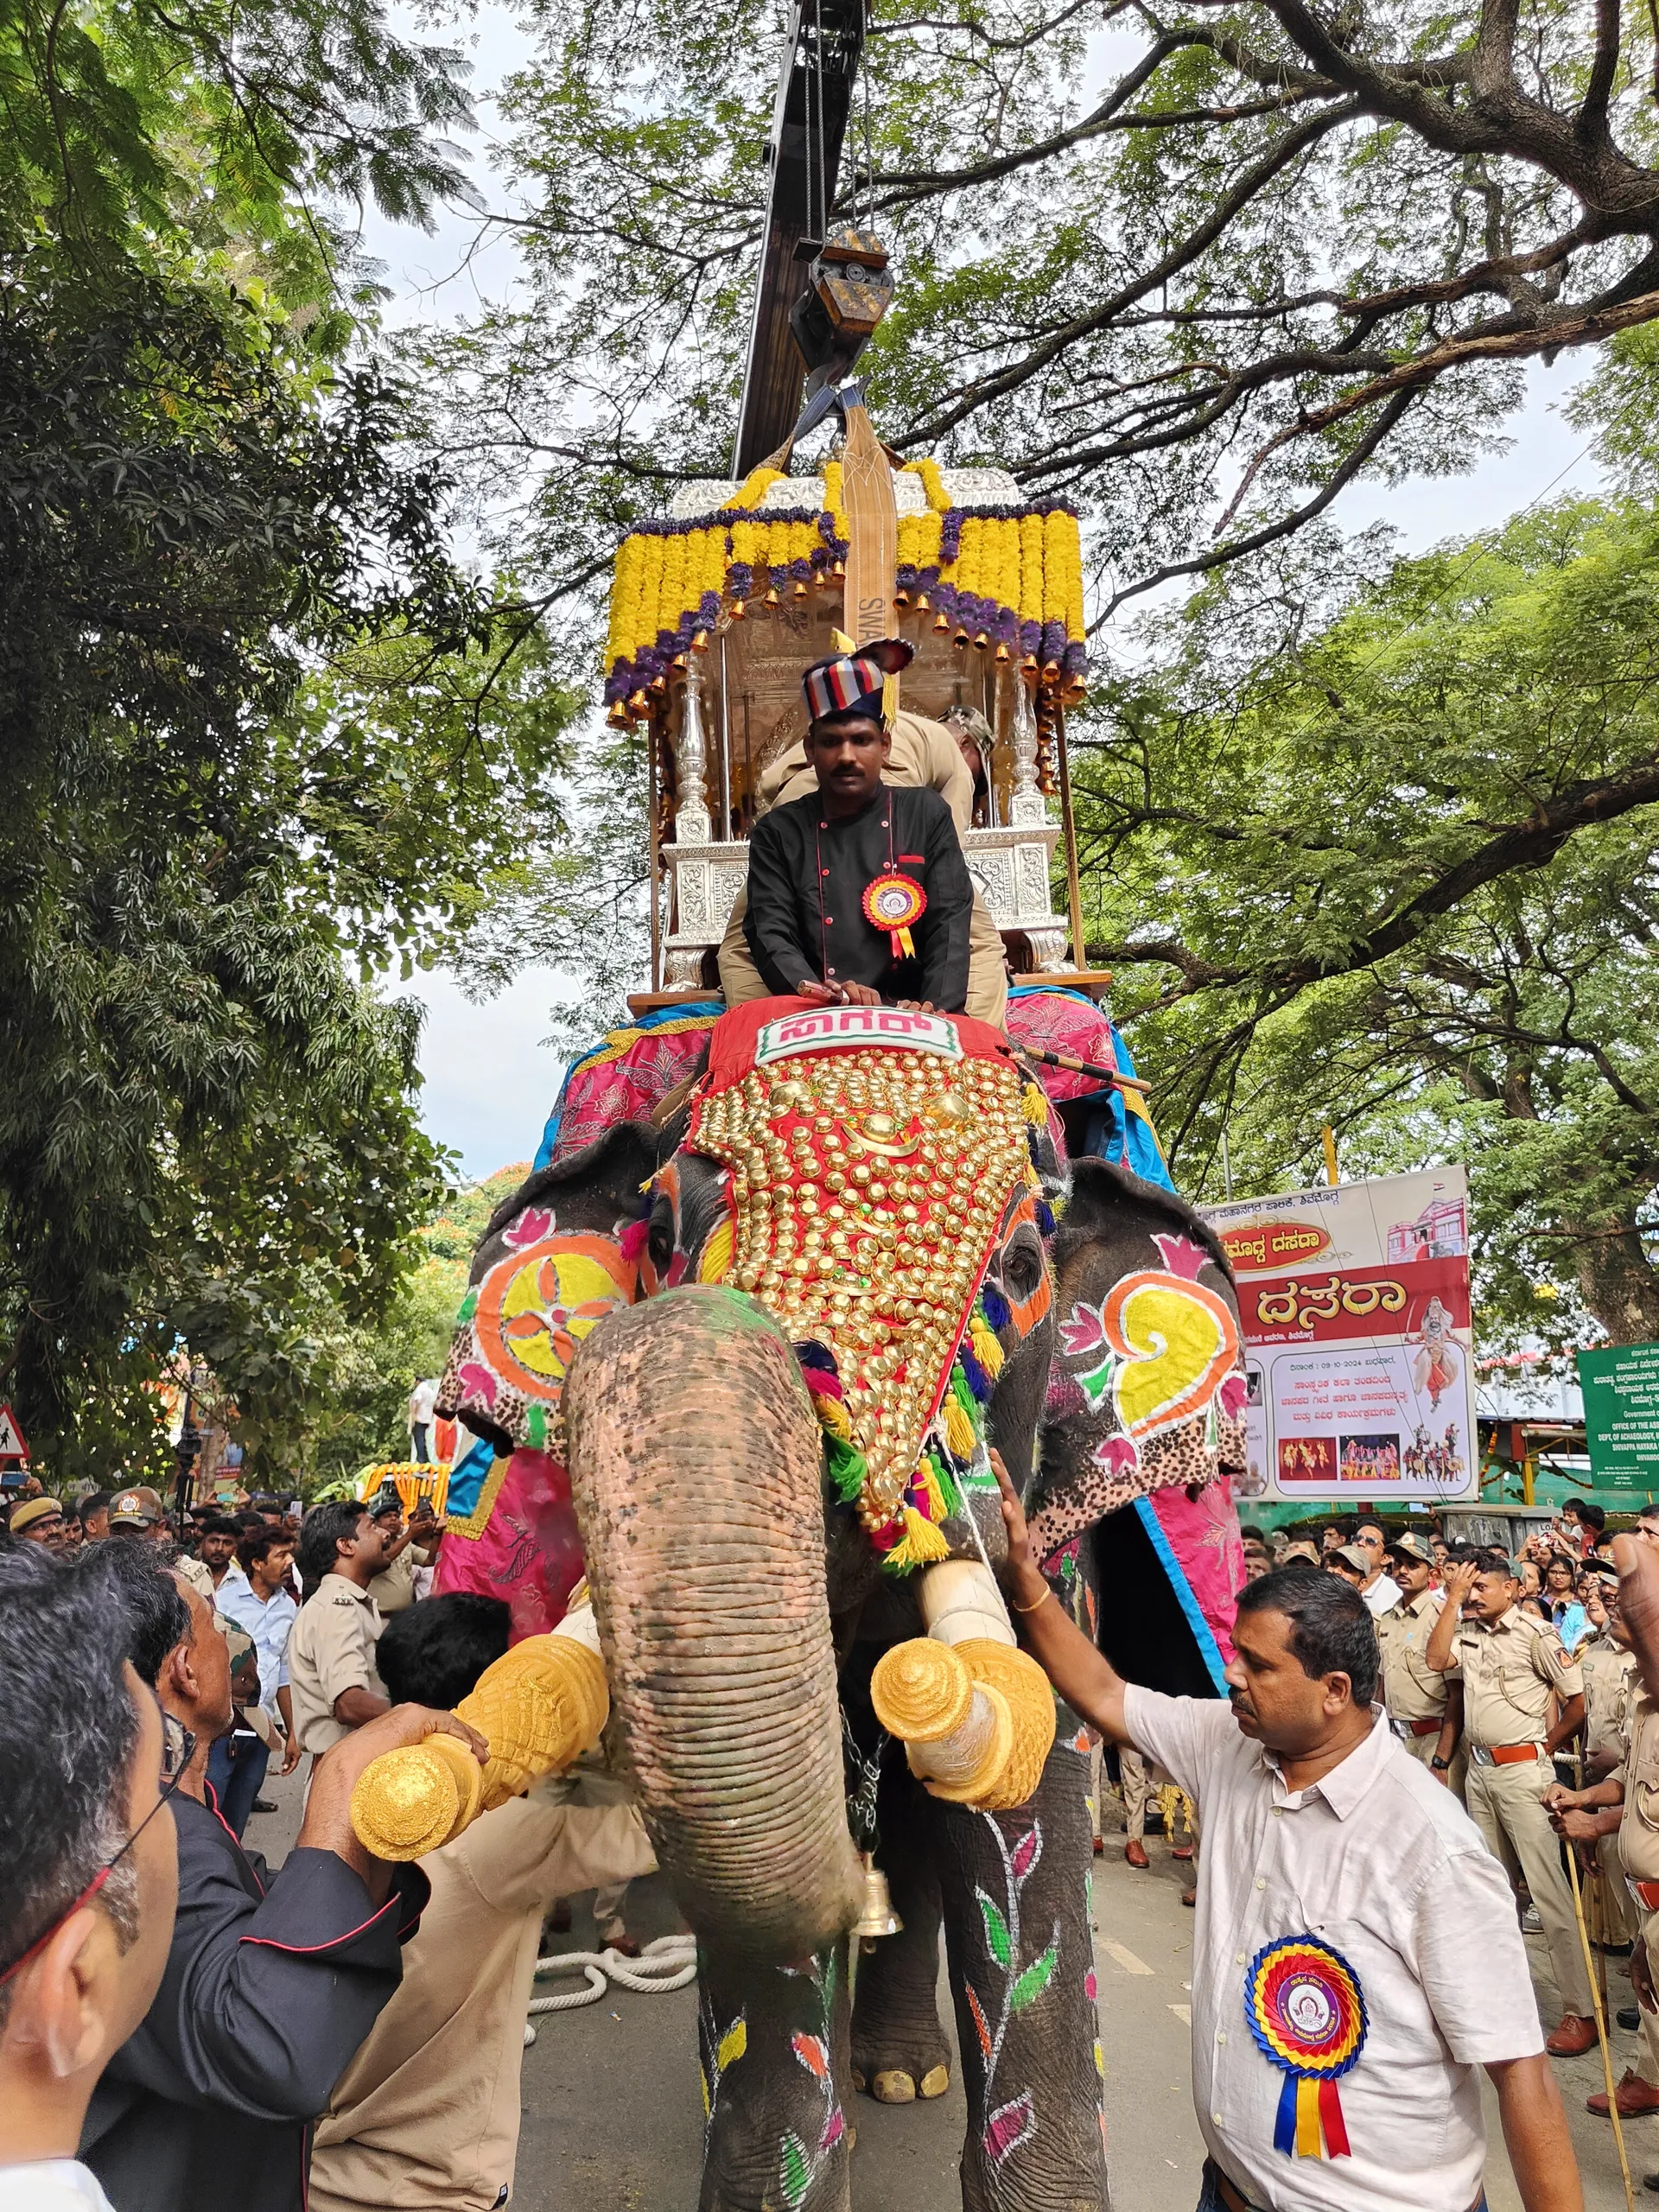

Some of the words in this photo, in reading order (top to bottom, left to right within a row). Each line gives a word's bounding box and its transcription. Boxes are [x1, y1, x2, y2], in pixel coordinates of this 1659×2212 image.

[858, 598, 886, 646] SWA
[779, 1010, 932, 1043] ಸಾಗರ್
[1220, 1202, 1262, 1218] ಮಹಾನಗರ
[1300, 1189, 1339, 1206] ಶಿವಮೊಗ್ಗ
[1223, 1234, 1266, 1264] ಮೊಗ್ಗ
[1271, 1229, 1320, 1253] ದಸರಾ
[1256, 1276, 1408, 1330] ದಸರಾ
[1624, 1409, 1656, 1418] Government
[1612, 1443, 1636, 1452] SHIVAPPA
